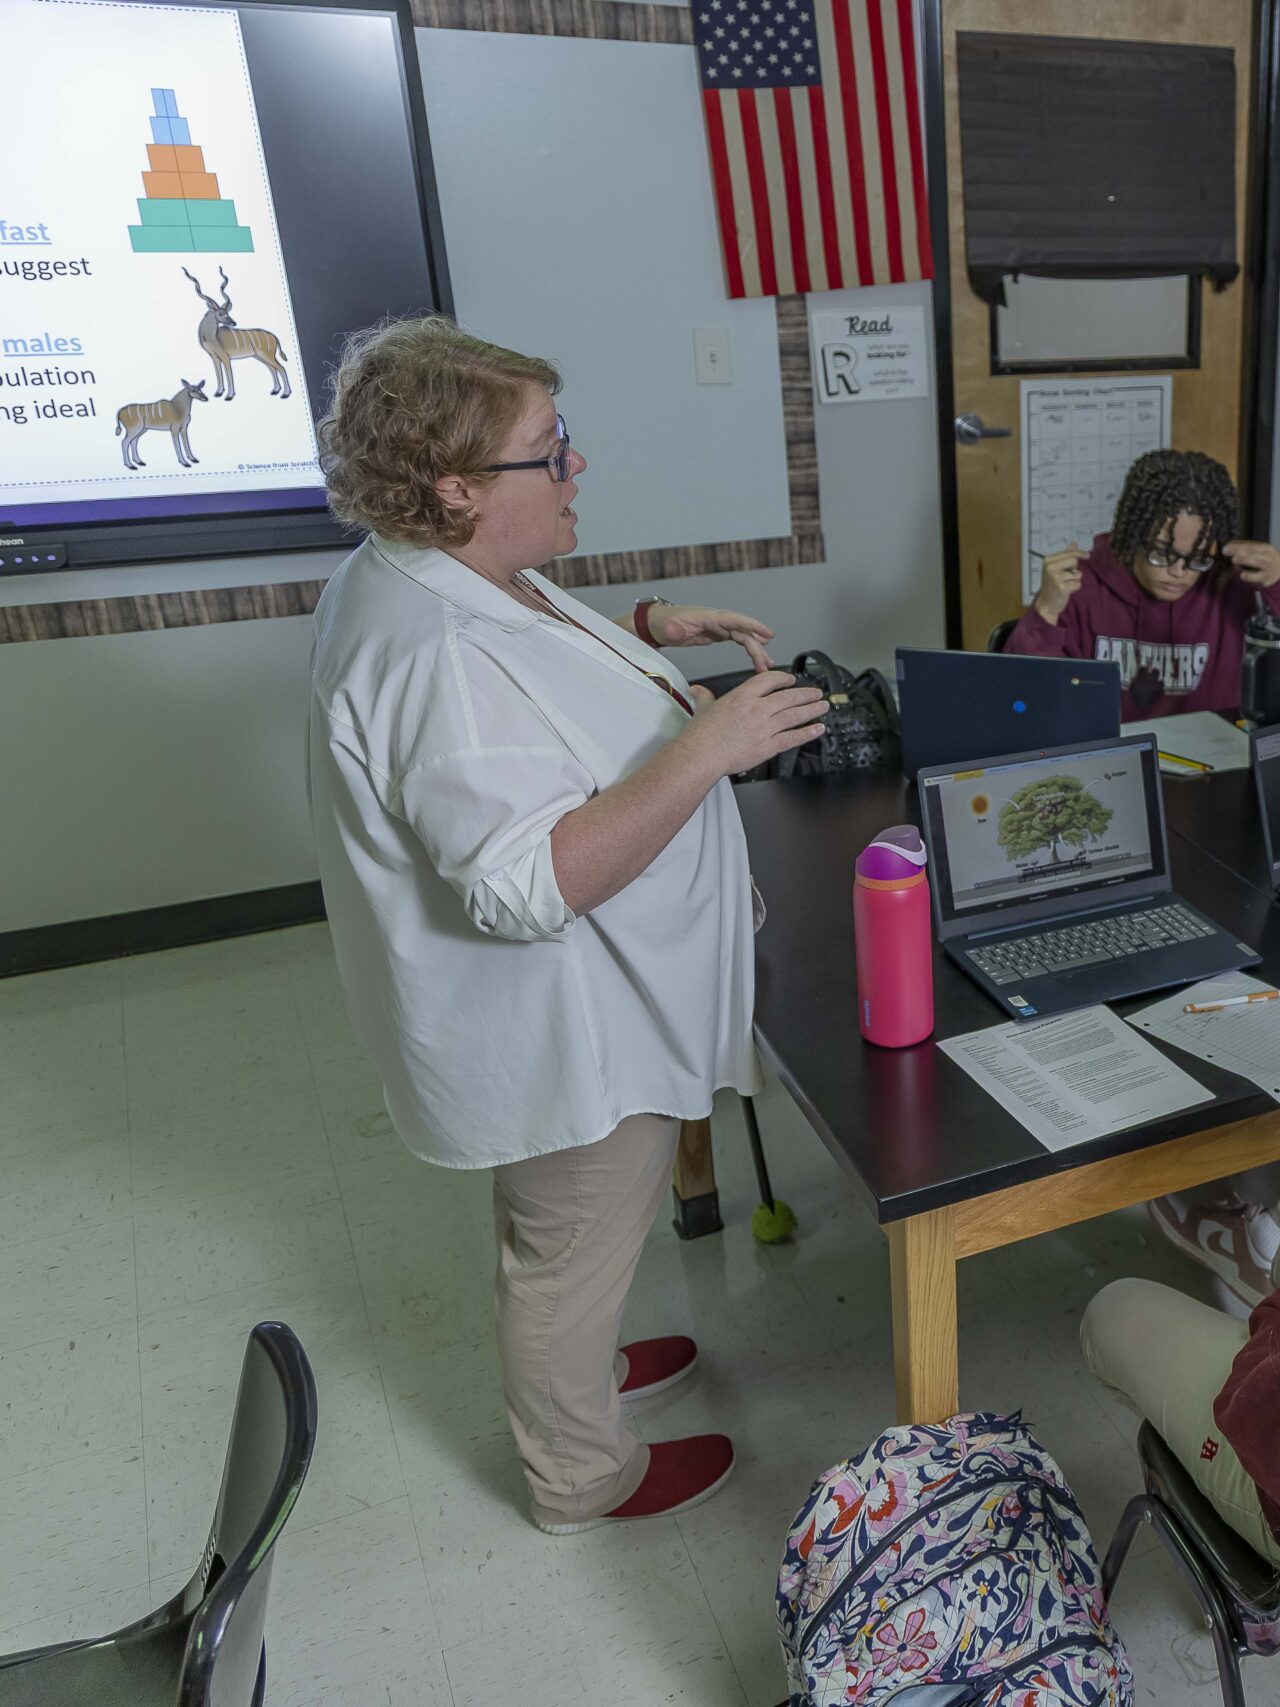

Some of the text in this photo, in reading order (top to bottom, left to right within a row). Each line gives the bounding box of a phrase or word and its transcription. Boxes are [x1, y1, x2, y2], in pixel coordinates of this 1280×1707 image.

[0, 220, 51, 243] fast
[844, 313, 893, 336] Read
[2, 333, 83, 353] males
[0, 366, 97, 387] ulation
[820, 342, 861, 397] R
[33, 397, 97, 419] ideal
